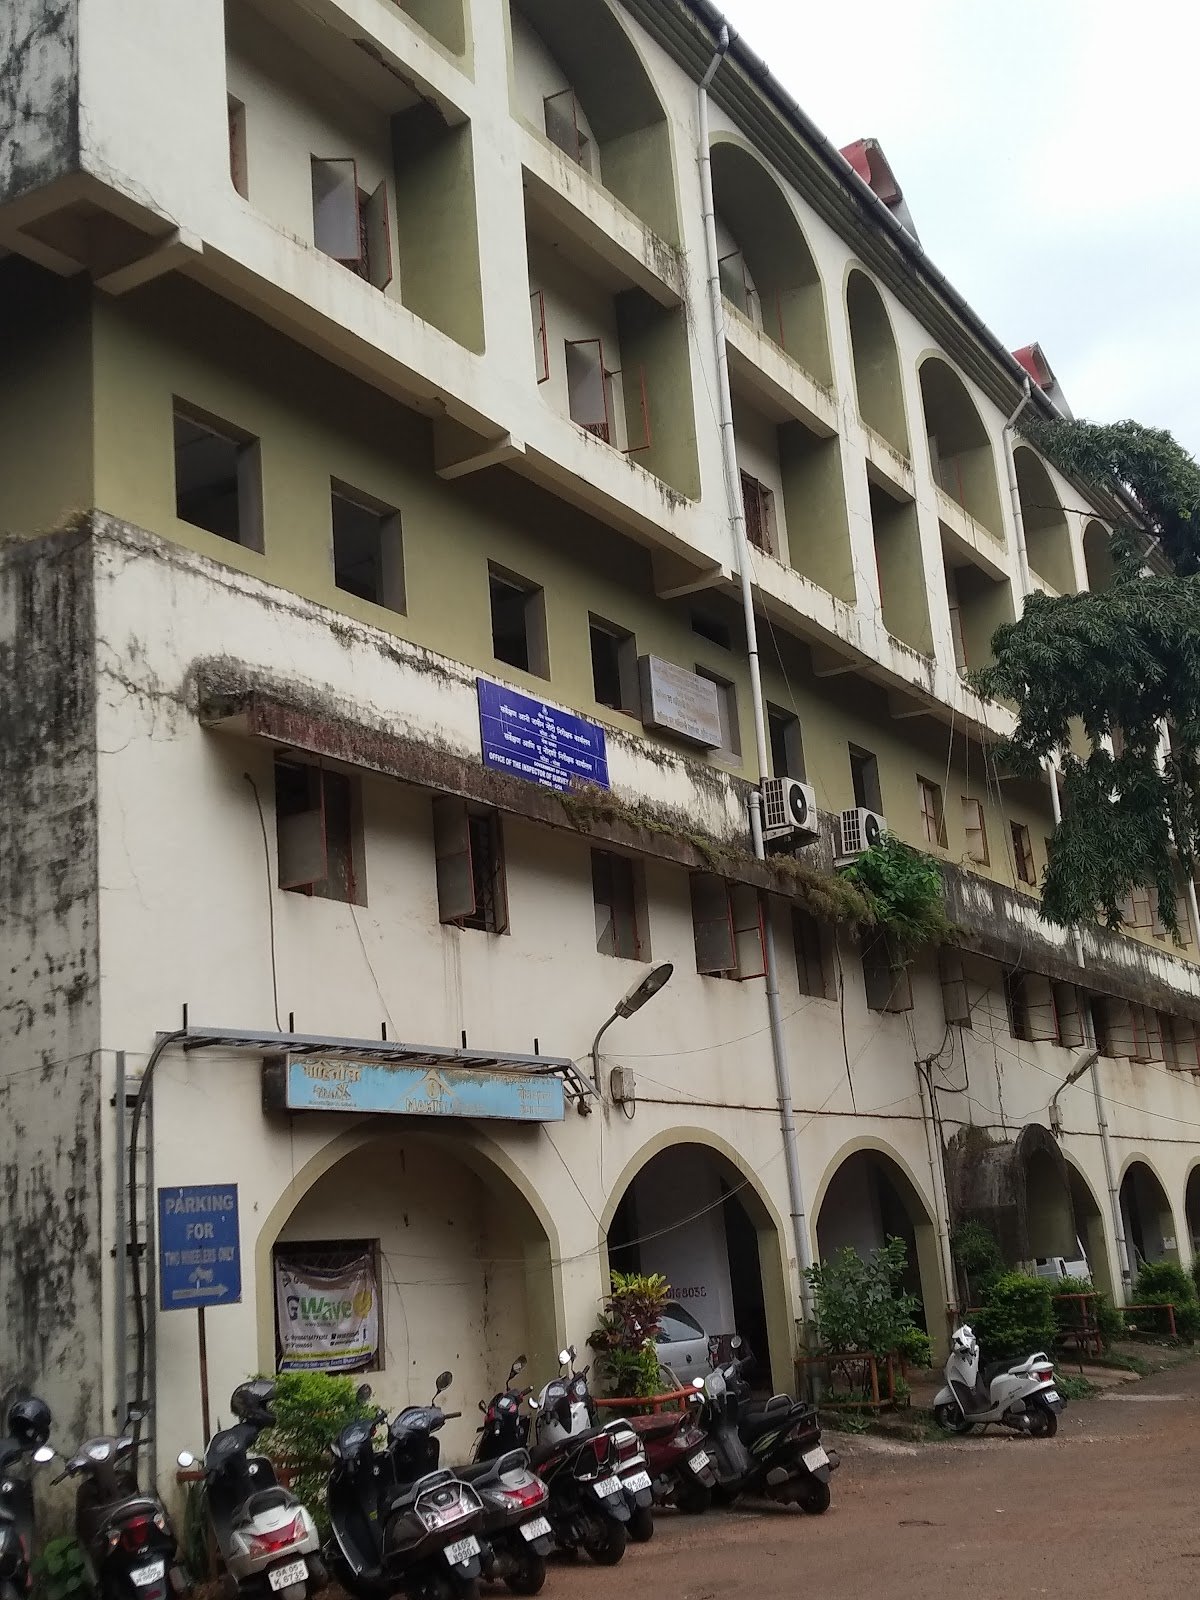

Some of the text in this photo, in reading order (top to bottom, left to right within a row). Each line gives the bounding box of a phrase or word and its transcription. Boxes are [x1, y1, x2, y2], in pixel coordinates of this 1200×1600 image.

[489, 753, 506, 764] OFFICE
[505, 758, 512, 766] OF
[513, 760, 522, 770] THE
[522, 764, 546, 778] INSPECTOR
[545, 772, 552, 780] OF
[553, 774, 569, 787] SURVEY
[534, 762, 556, 773] GOVERNMENT
[540, 779, 553, 788] PONDA
[165, 1195, 234, 1215] PARKING
[186, 1222, 214, 1240] FOR
[164, 1246, 234, 1266] TWO WHEELERS ONLY
